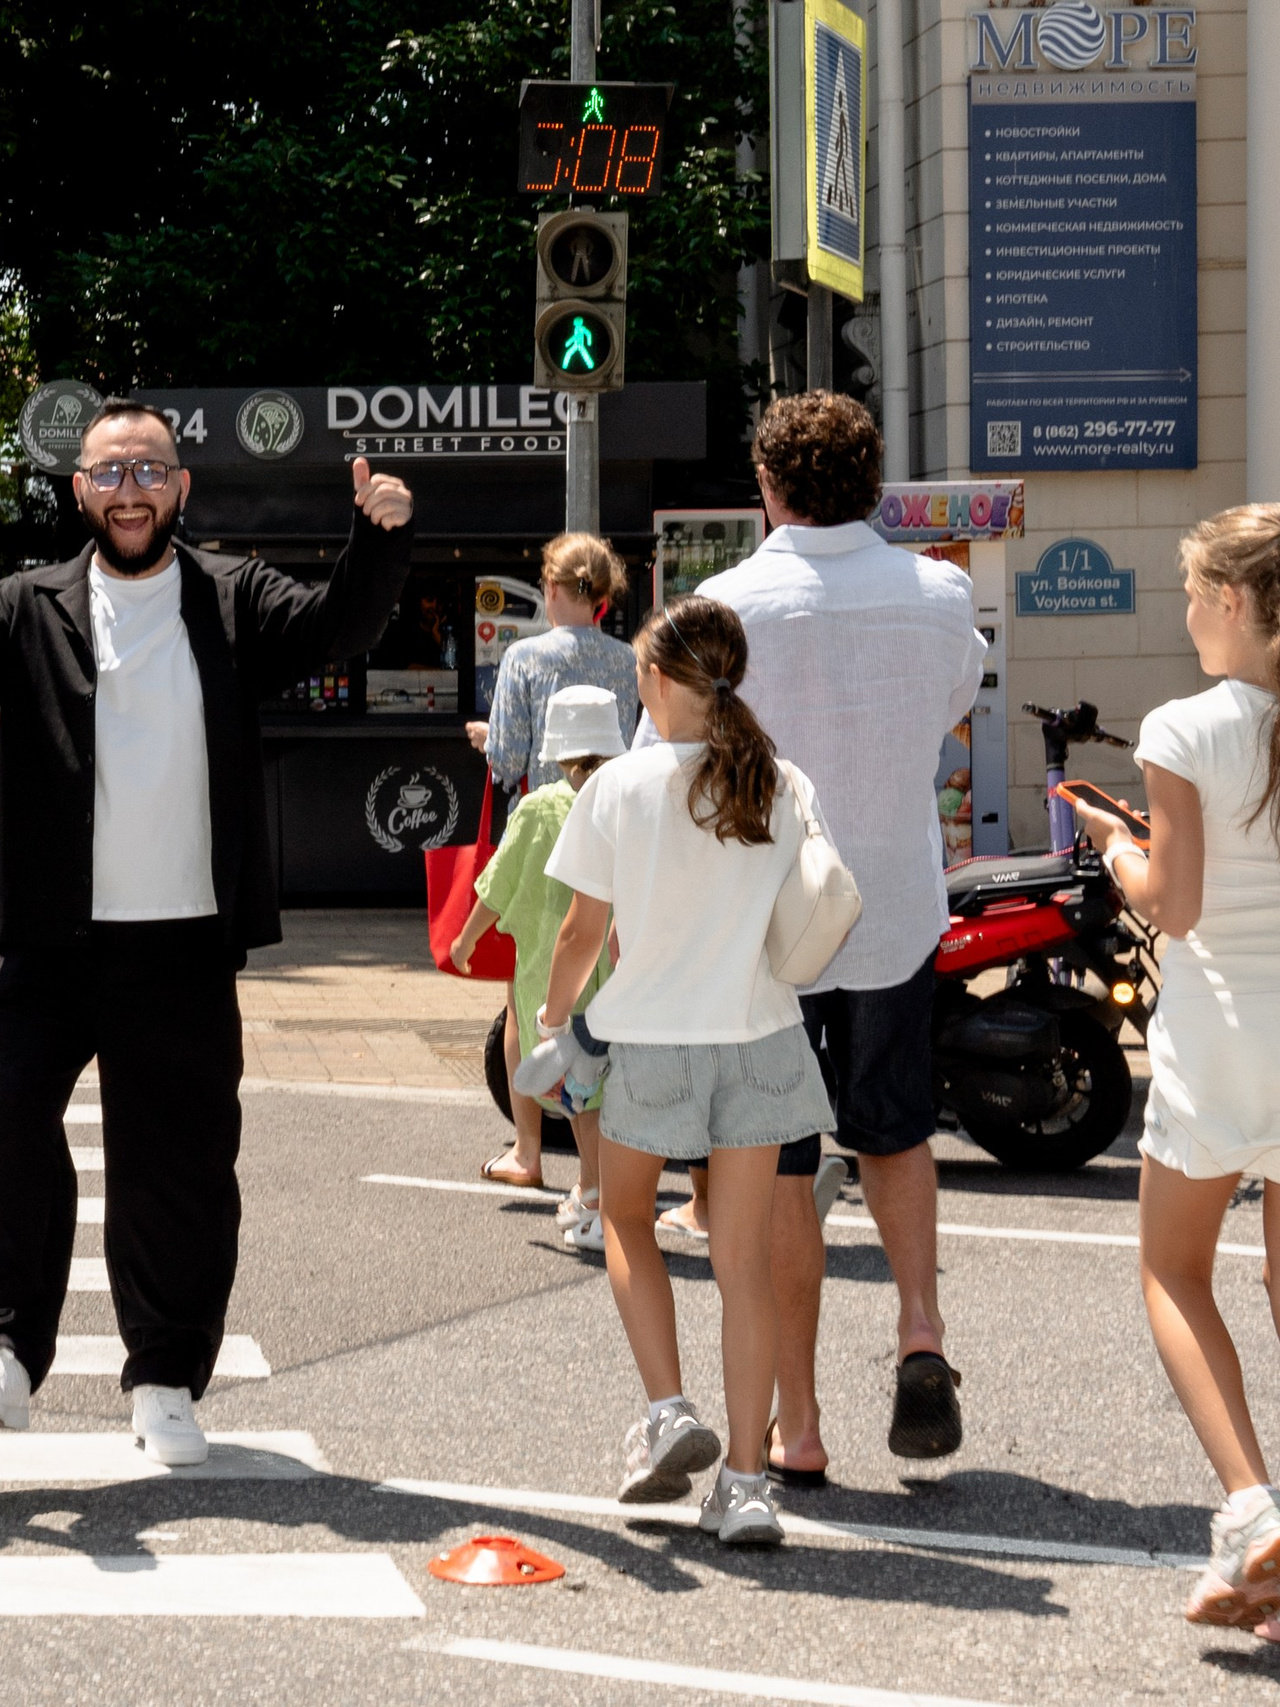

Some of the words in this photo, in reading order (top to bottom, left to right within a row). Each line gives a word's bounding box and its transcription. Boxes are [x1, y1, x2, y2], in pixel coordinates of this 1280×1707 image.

[978, 79, 1191, 98] недвижимость
[996, 126, 1080, 138] НОВОСТРОЙКИ
[996, 151, 1058, 163] КВАРТИРЫ,
[1060, 150, 1144, 161] АПАРТАМЕНТЫ
[996, 174, 1072, 186] КОТТЕДЖНЫЕ
[1075, 174, 1131, 186] ПОСЕЛКИ,
[1133, 173, 1167, 185] ДОМА
[996, 198, 1065, 210] ЗЕМЕЛЬНЫЕ
[1068, 198, 1117, 209] УЧАСТКИ
[996, 222, 1086, 233] КОММЕРЧЕСКАЯ
[1089, 221, 1184, 233] НЕДВИЖИМОСТЬ
[996, 246, 1105, 258] ИНВЕСТИЦИОННЫЕ
[1108, 245, 1161, 256] ПРОЕКТЫ
[996, 270, 1081, 282] ЮРИДИЧЕСКИЕ
[1084, 269, 1126, 280] УСЛУГИ
[996, 294, 1048, 305] ИПОТЕКА
[996, 316, 1046, 329] ДИЗАЙН,
[1048, 317, 1094, 328] РЕМОНТ
[996, 340, 1090, 352] СТРОИТЕЛЬСТВО
[986, 398, 1028, 408] РАБОТАЕМ
[1029, 398, 1041, 408] ПО
[1043, 397, 1063, 407] ВСЕЙ
[1065, 397, 1115, 407] ТЕРРИТОРИИ
[1117, 396, 1128, 407] РФ
[1137, 396, 1147, 406] ЗА
[1149, 396, 1187, 406] РУБЕЖОМ
[1045, 424, 1079, 439] (862)
[1084, 420, 1176, 437] 296-77-77
[356, 438, 462, 452] STREET
[480, 436, 562, 451] FOOD
[1033, 442, 1174, 456] www.more-realty.ru
[871, 493, 1010, 529] ОЖЕНОЕ
[1058, 548, 1092, 573] 1/1
[1031, 579, 1052, 594] ул.
[1057, 576, 1120, 591] Войкова
[1034, 595, 1096, 613] Voykova
[1100, 596, 1118, 608] st.
[388, 806, 438, 835] Coffee
